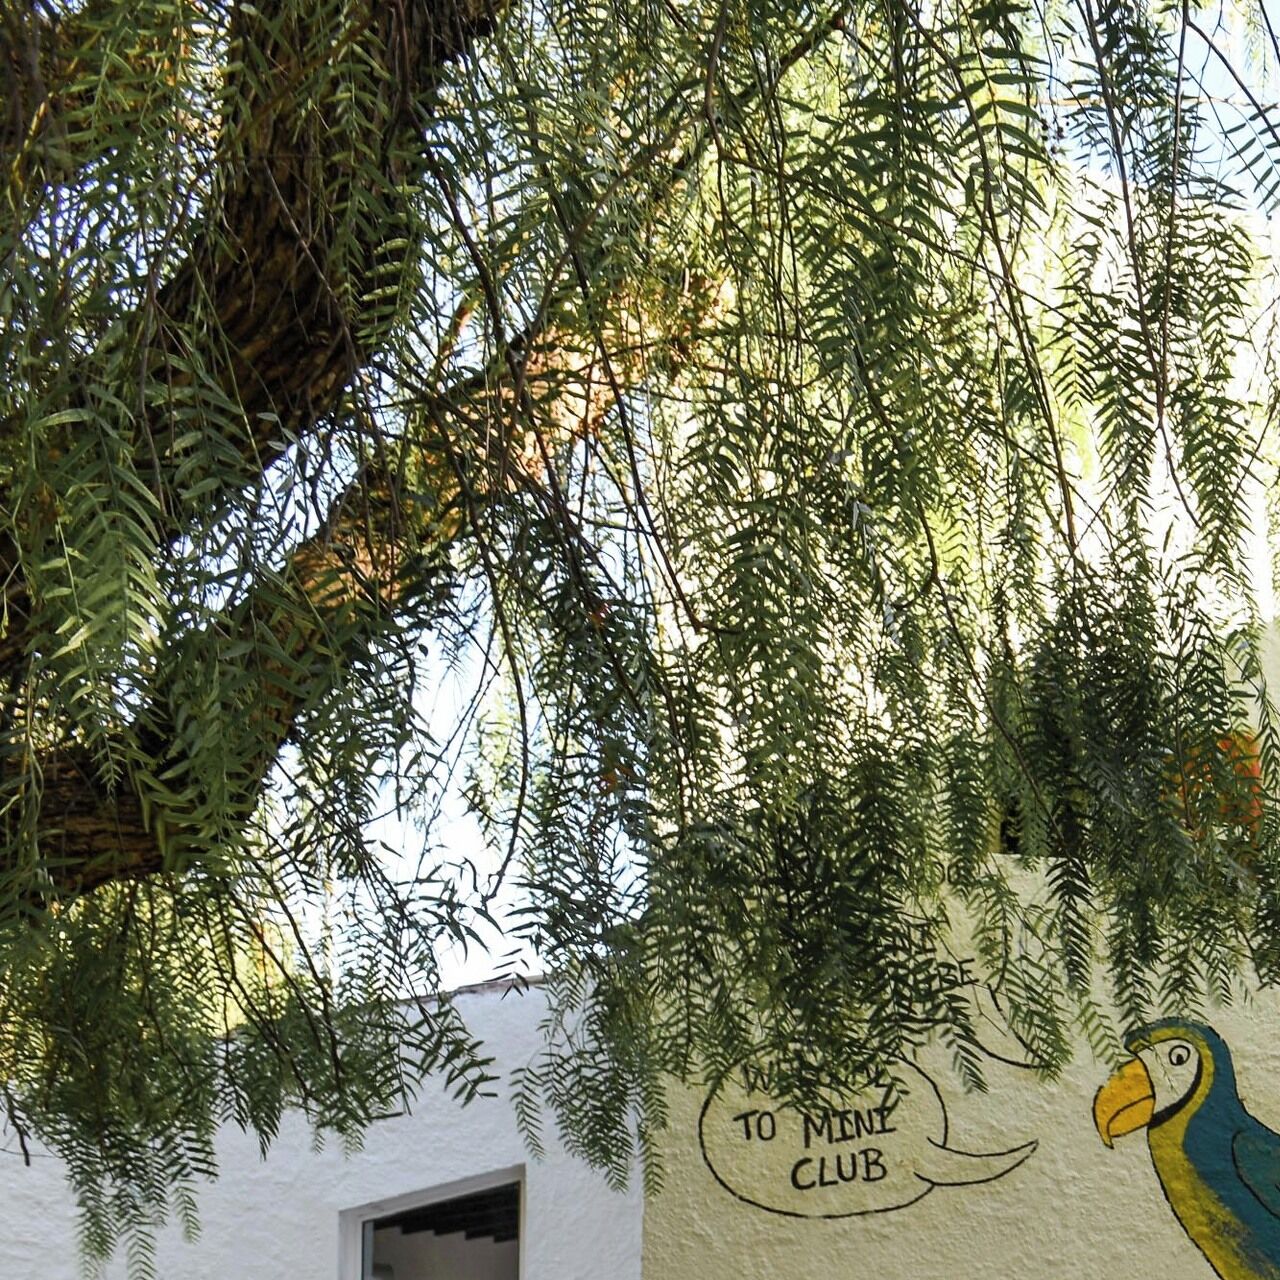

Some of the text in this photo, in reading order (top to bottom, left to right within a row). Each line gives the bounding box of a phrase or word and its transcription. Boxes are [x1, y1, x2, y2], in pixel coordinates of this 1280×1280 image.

[733, 1106, 897, 1149] TO MINI
[791, 1147, 888, 1190] CLUB
